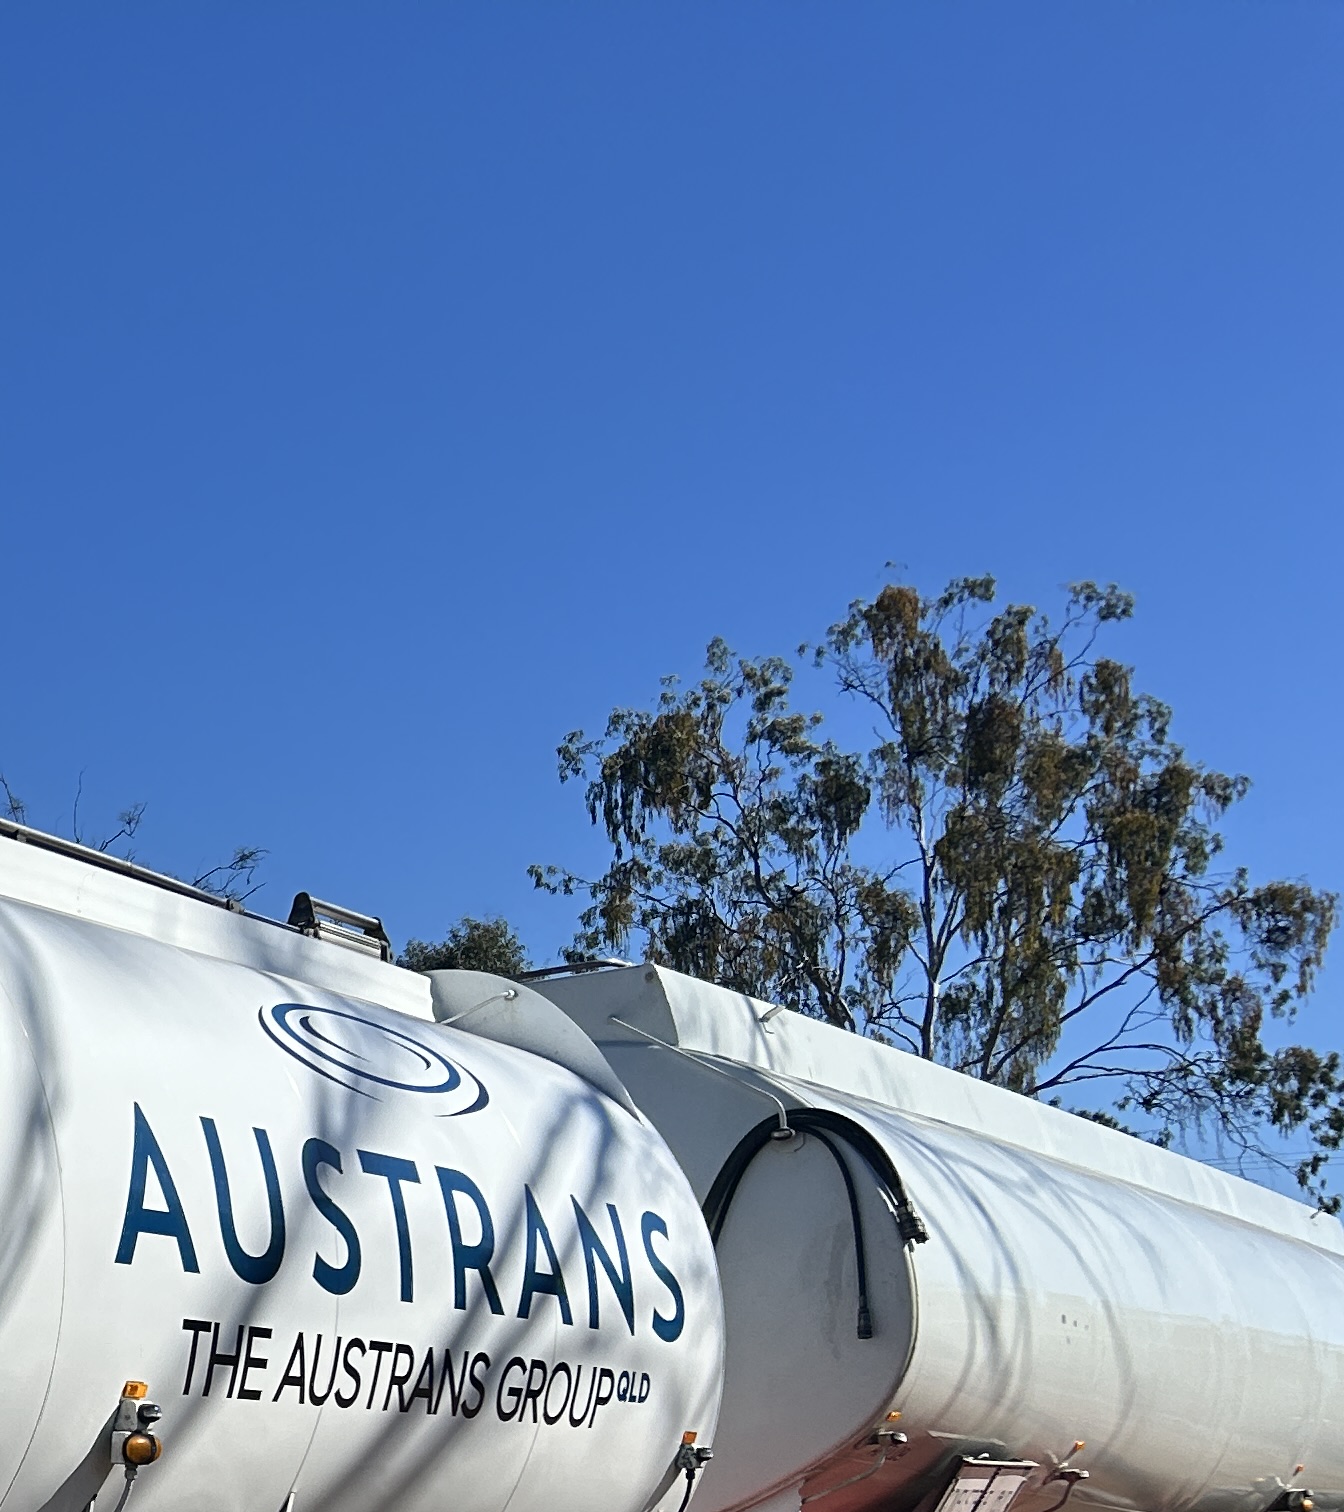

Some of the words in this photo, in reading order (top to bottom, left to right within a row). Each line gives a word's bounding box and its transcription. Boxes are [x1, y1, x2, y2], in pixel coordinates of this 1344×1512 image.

[115, 1101, 686, 1343] AUSTRANS
[181, 1318, 273, 1402] THE
[274, 1331, 493, 1422] AUSTRANS
[496, 1357, 614, 1429] GROUP
[617, 1371, 650, 1405] QLD
